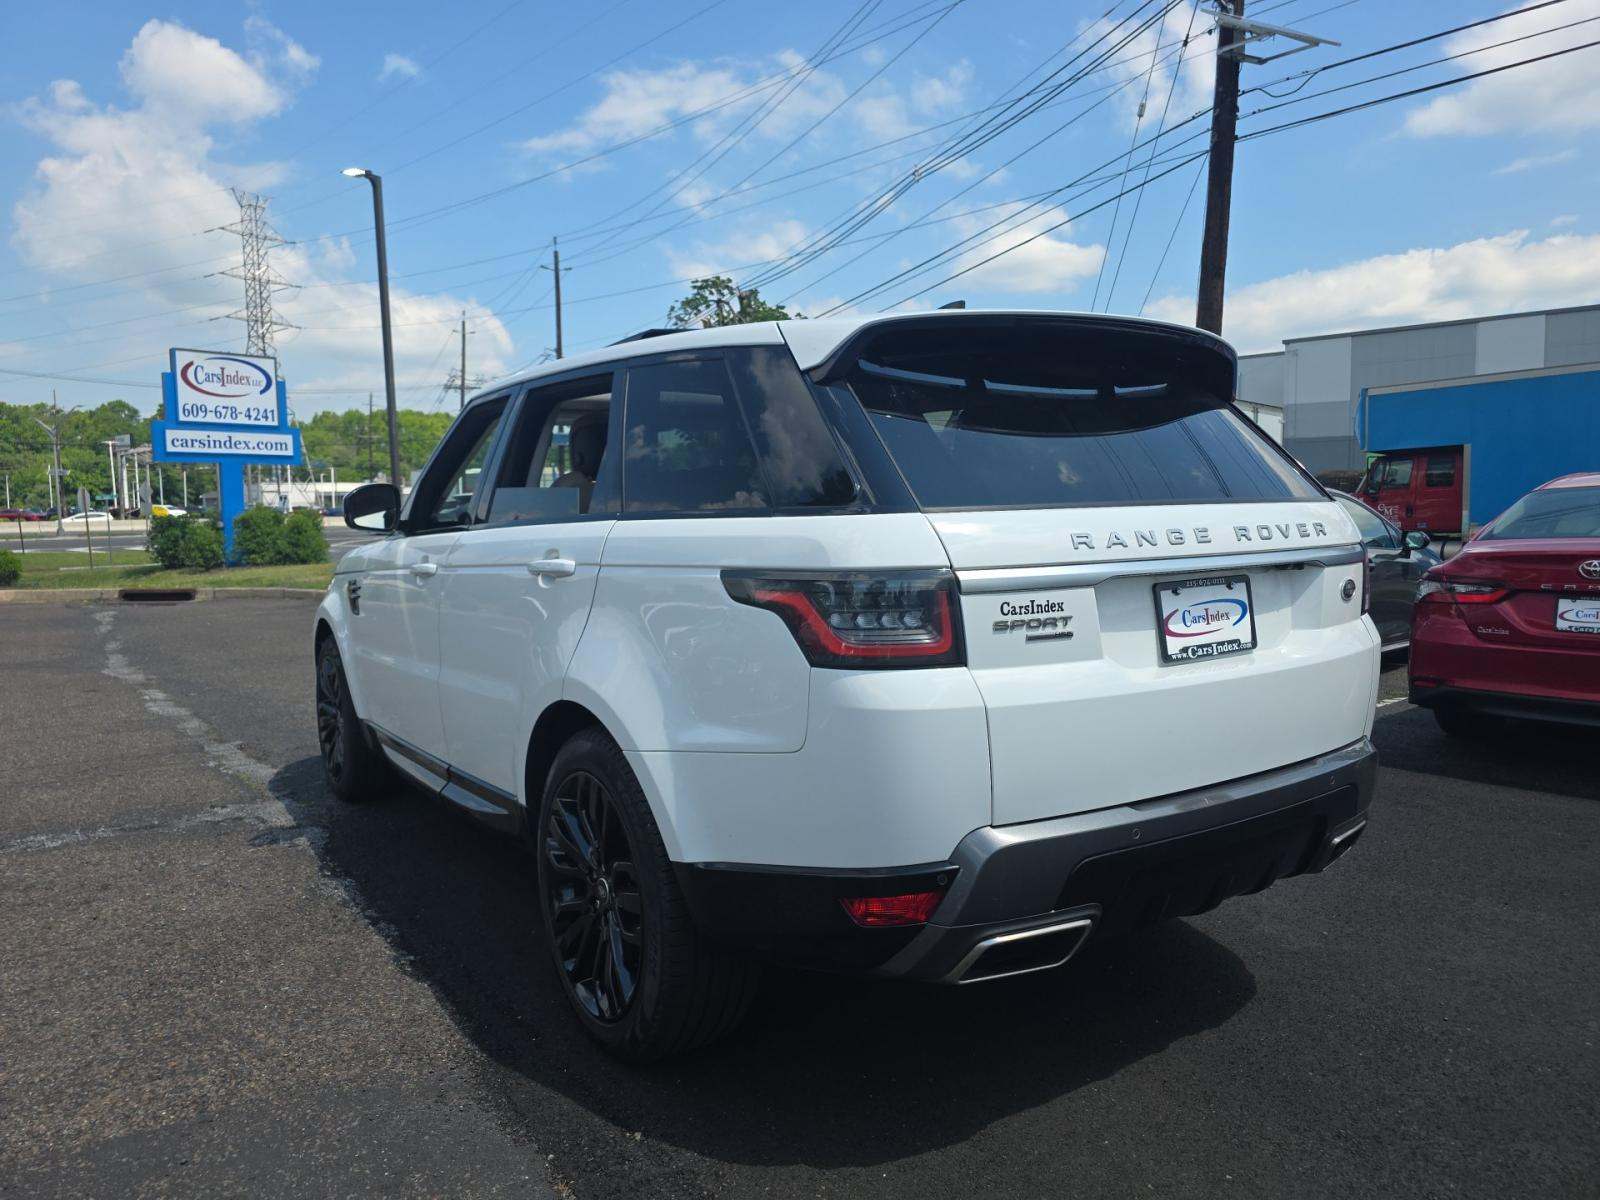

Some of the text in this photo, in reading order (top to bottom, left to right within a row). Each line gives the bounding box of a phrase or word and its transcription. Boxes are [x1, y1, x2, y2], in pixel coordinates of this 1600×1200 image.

[194, 364, 250, 387] CarsIndex
[182, 403, 275, 422] 609-678-4241
[171, 435, 288, 451] carsindex.com
[1070, 522, 1328, 550] RANGE ROVER
[1000, 600, 1065, 616] CarsIndex
[1182, 608, 1230, 627] CarsIndex
[992, 615, 1073, 632] SPORT
[1171, 641, 1252, 660] www.CarsIndex.com
